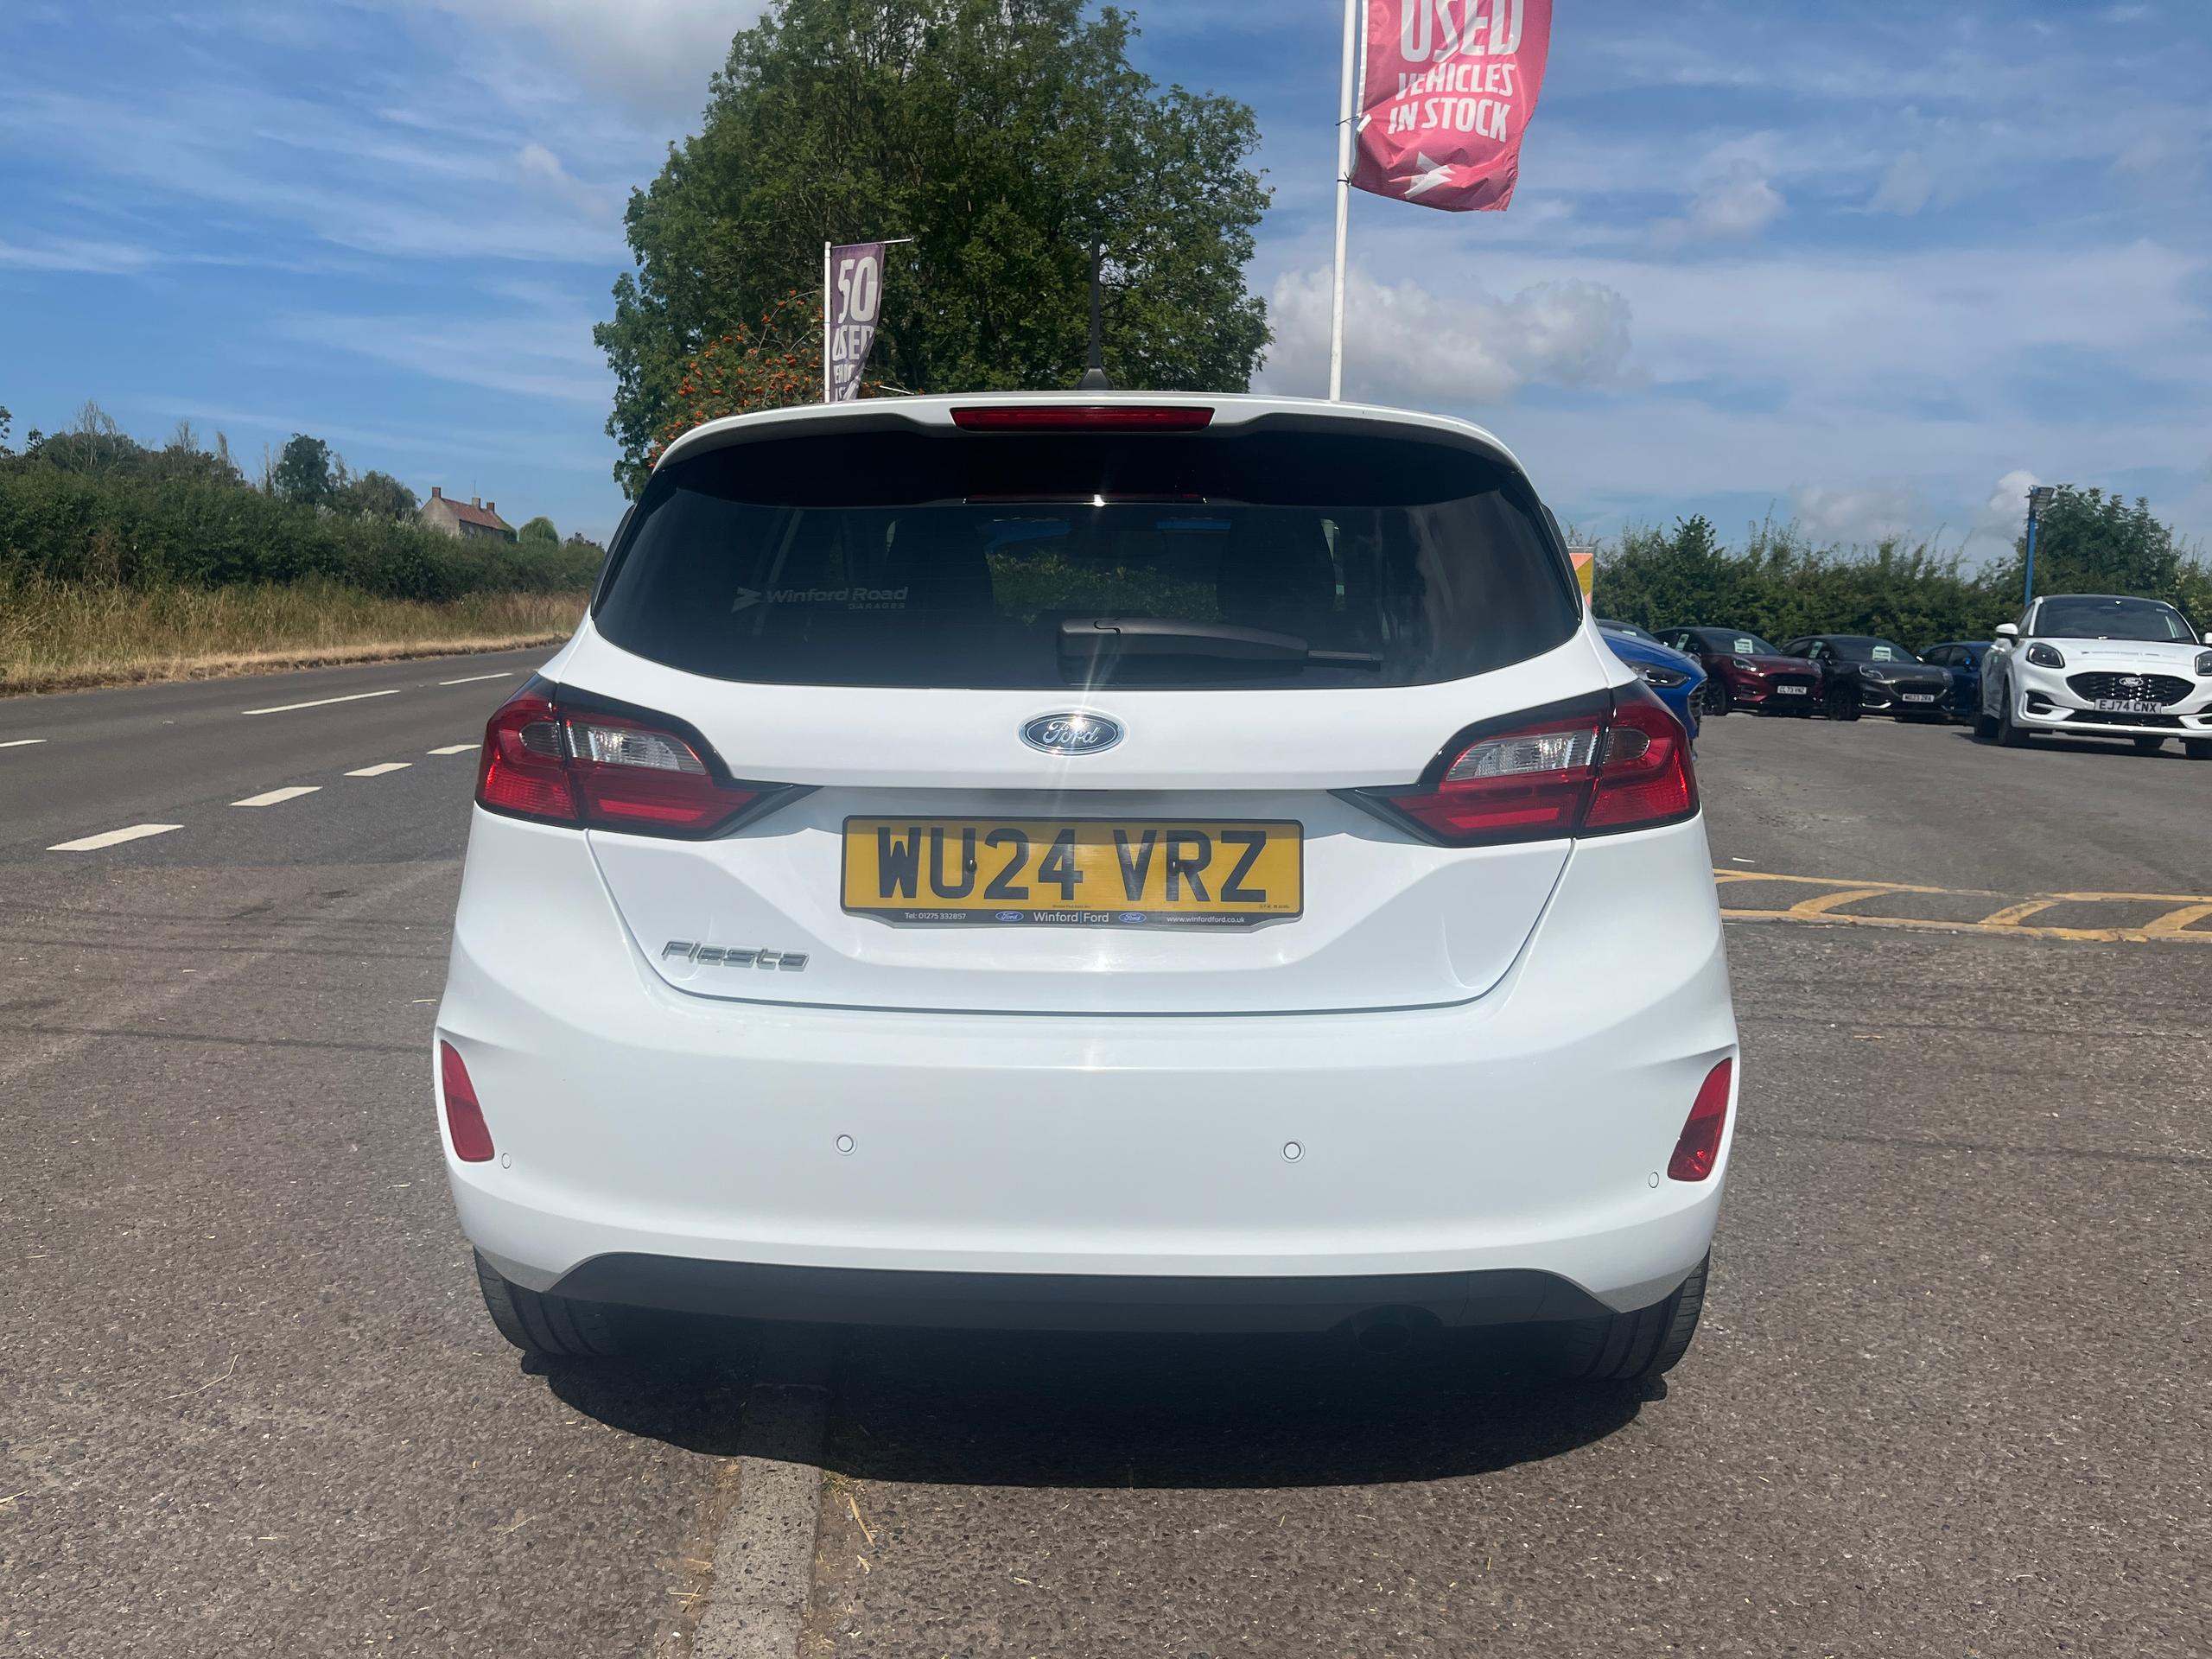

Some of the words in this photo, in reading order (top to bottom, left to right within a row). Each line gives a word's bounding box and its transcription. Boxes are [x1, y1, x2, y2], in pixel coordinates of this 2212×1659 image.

[1400, 0, 1524, 62] USED
[1395, 62, 1516, 101] VEHICLES
[1388, 101, 1419, 135] IN
[1421, 97, 1510, 143] STOCK
[837, 256, 879, 324] 50
[766, 588, 849, 603] Winford
[852, 587, 909, 601] Road
[2099, 700, 2130, 711] EJ74
[2133, 702, 2157, 713] CNX
[1043, 720, 1101, 744] Ford
[877, 826, 1084, 900] WU24
[1112, 829, 1267, 903] VRZ
[1033, 912, 1078, 922] Winford
[1084, 912, 1109, 923] Ford
[1166, 915, 1245, 924] www.winfordford.co.uk
[661, 940, 810, 972] Fiesta
